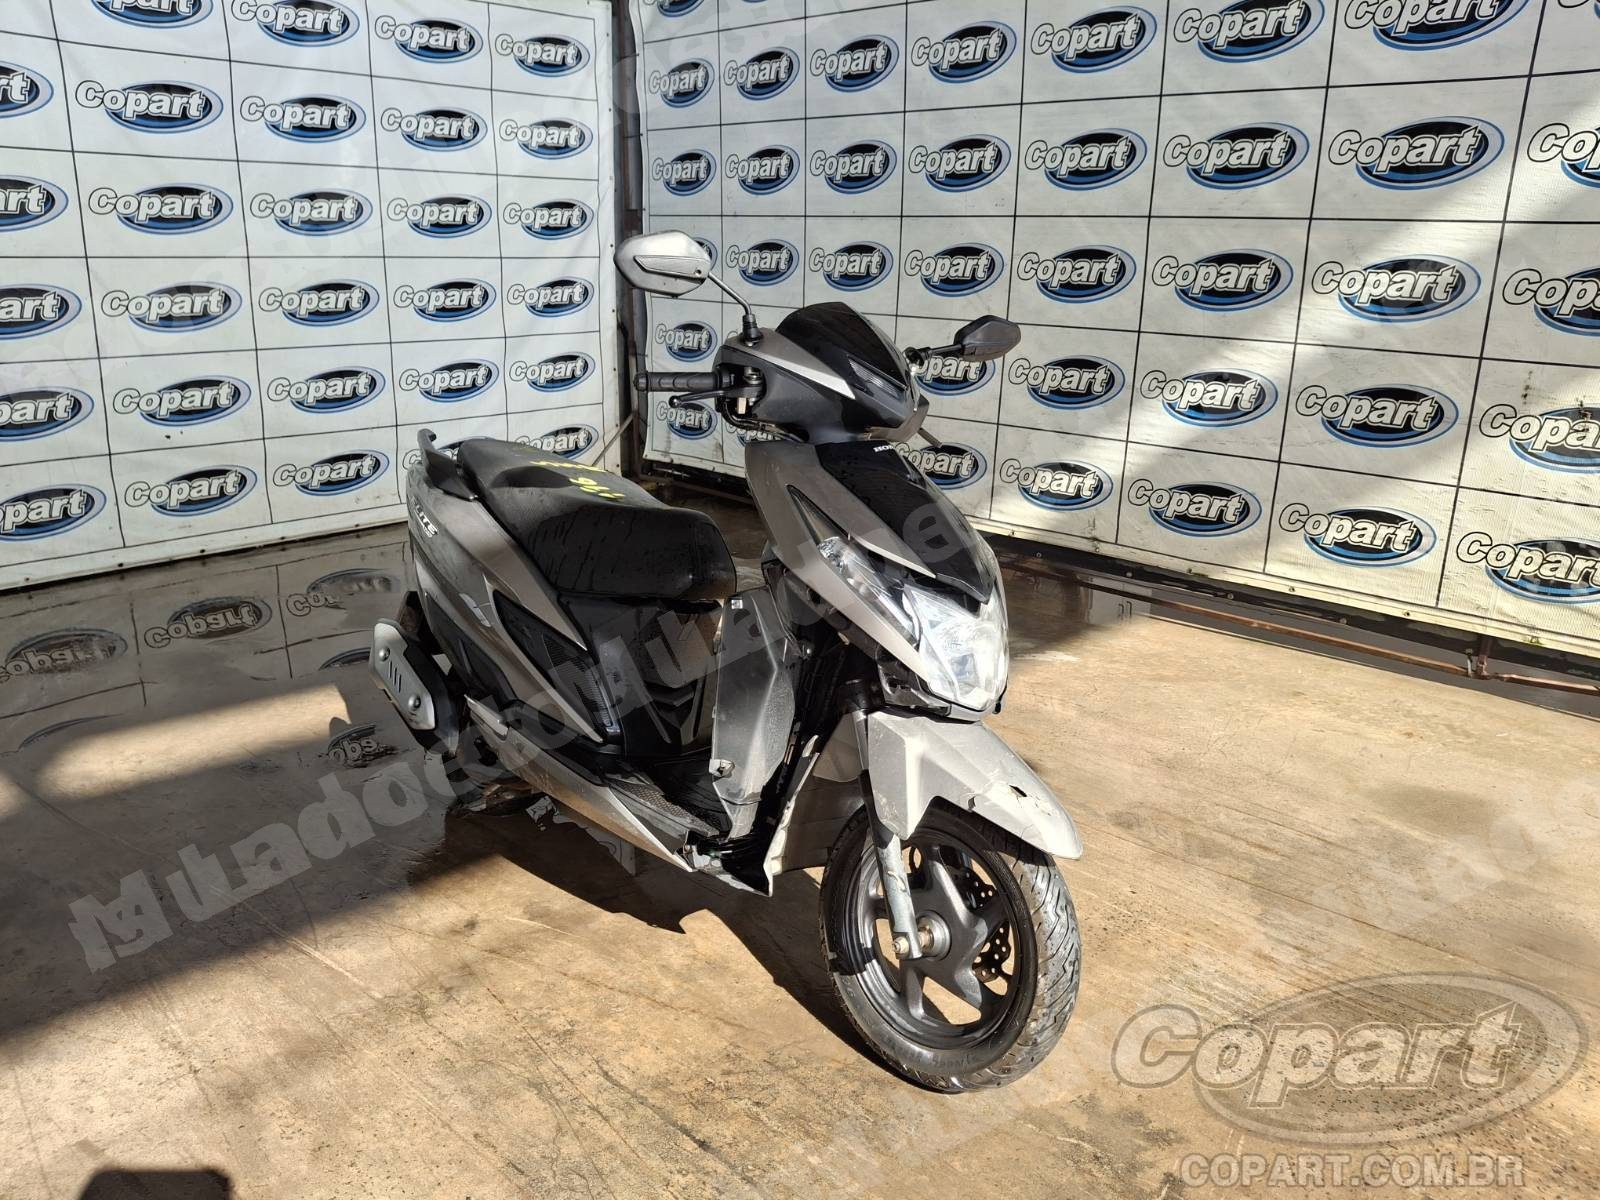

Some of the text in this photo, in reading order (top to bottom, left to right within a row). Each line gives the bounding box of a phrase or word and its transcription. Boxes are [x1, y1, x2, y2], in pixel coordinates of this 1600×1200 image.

[231, 0, 343, 32] Copart
[375, 15, 472, 51] Copart
[1174, 0, 1304, 48] Copart
[495, 34, 578, 65] Copart
[911, 28, 1004, 71] Copart
[1031, 14, 1142, 62] Copart
[723, 53, 791, 91] Copart
[810, 42, 888, 82] Copart
[649, 64, 706, 98] Copart
[75, 80, 205, 119] Copart
[240, 95, 350, 131] Copart
[381, 107, 474, 140] Copart
[500, 119, 581, 148] Copart
[810, 148, 886, 182] Copart
[909, 142, 998, 181] Copart
[1025, 136, 1131, 177] Copart
[1163, 132, 1291, 174] Copart
[1329, 125, 1482, 174] Copart
[652, 155, 708, 186] Copart
[725, 151, 792, 185] Copart
[89, 188, 216, 223] Copart
[250, 193, 357, 226] Copart
[387, 197, 480, 228] Copart
[503, 203, 584, 231] Copart
[725, 244, 791, 272] Copart
[809, 246, 882, 279] Copart
[904, 249, 991, 284] Copart
[1017, 250, 1121, 288] Copart
[1152, 256, 1275, 295] Copart
[394, 285, 485, 312] Copart
[507, 283, 585, 312] Copart
[1312, 261, 1459, 305] Copart
[1502, 268, 1600, 317] Cop
[101, 288, 227, 323] Copart
[259, 286, 365, 318] Copart
[655, 323, 709, 352] Copart
[267, 372, 370, 405] Copart
[400, 365, 489, 394] Copart
[509, 358, 586, 383] Copart
[1008, 358, 1110, 395] Copart
[113, 380, 235, 417] Copart
[1140, 370, 1260, 410] Copart
[1296, 385, 1439, 431] Copart
[656, 401, 710, 430] Copart
[1480, 403, 1600, 452] Copa
[124, 469, 241, 509] Copart
[273, 455, 375, 488] Copart
[1000, 458, 1098, 497] Copart
[0, 489, 87, 533] part
[1128, 479, 1246, 523] Copart
[1279, 503, 1420, 552] Copart
